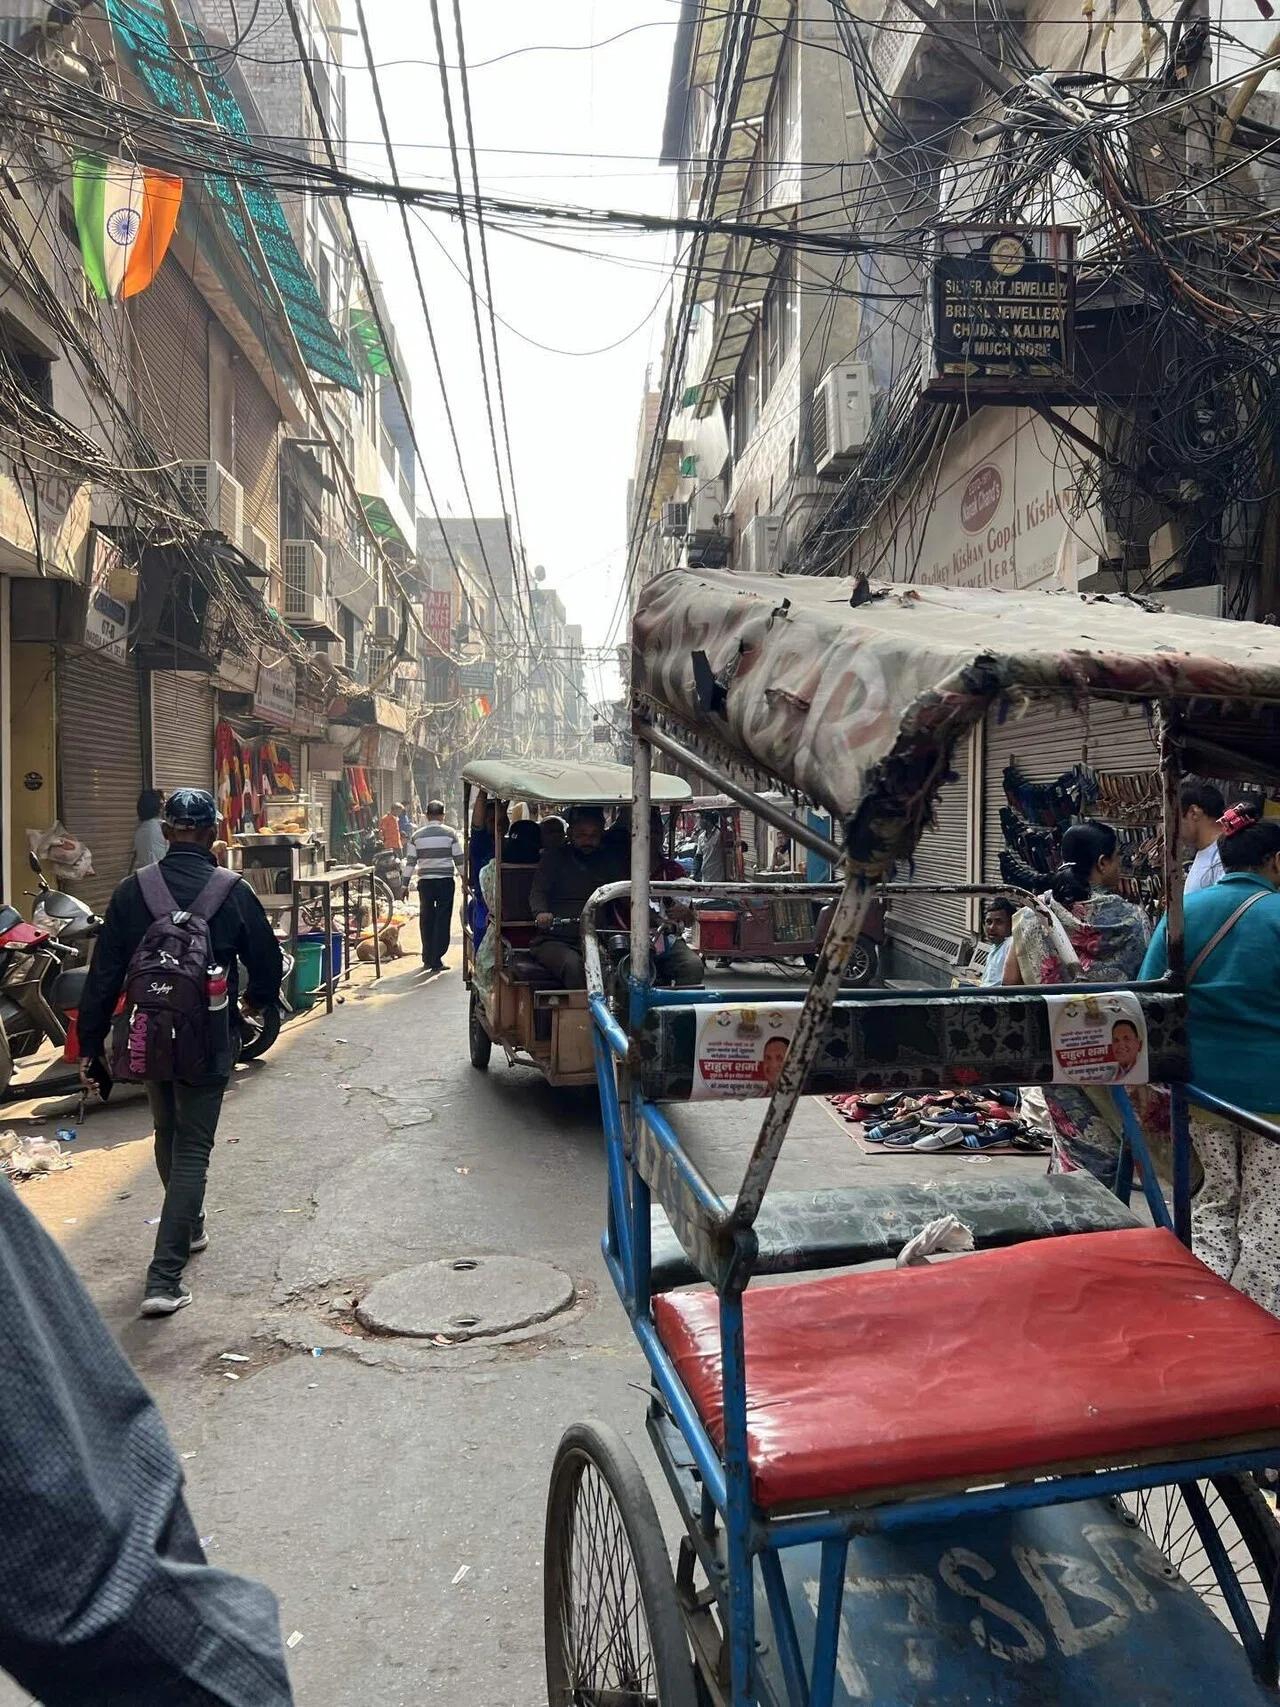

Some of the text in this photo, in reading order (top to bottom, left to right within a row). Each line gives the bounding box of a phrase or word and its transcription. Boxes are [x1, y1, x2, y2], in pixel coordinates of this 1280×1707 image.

[984, 280, 1006, 295] ART
[1008, 281, 1067, 297] JEWELLERY
[945, 304, 1067, 320] BRIDAL JEWELLERY
[1013, 324, 1060, 339] KALIRA
[974, 342, 1011, 356] MUCH
[1014, 342, 1051, 357] MORE
[129, 1012, 149, 1073] SKYBAGS
[1060, 1050, 1085, 1060] राहुल
[704, 1061, 758, 1072] राहुल शर्मा
